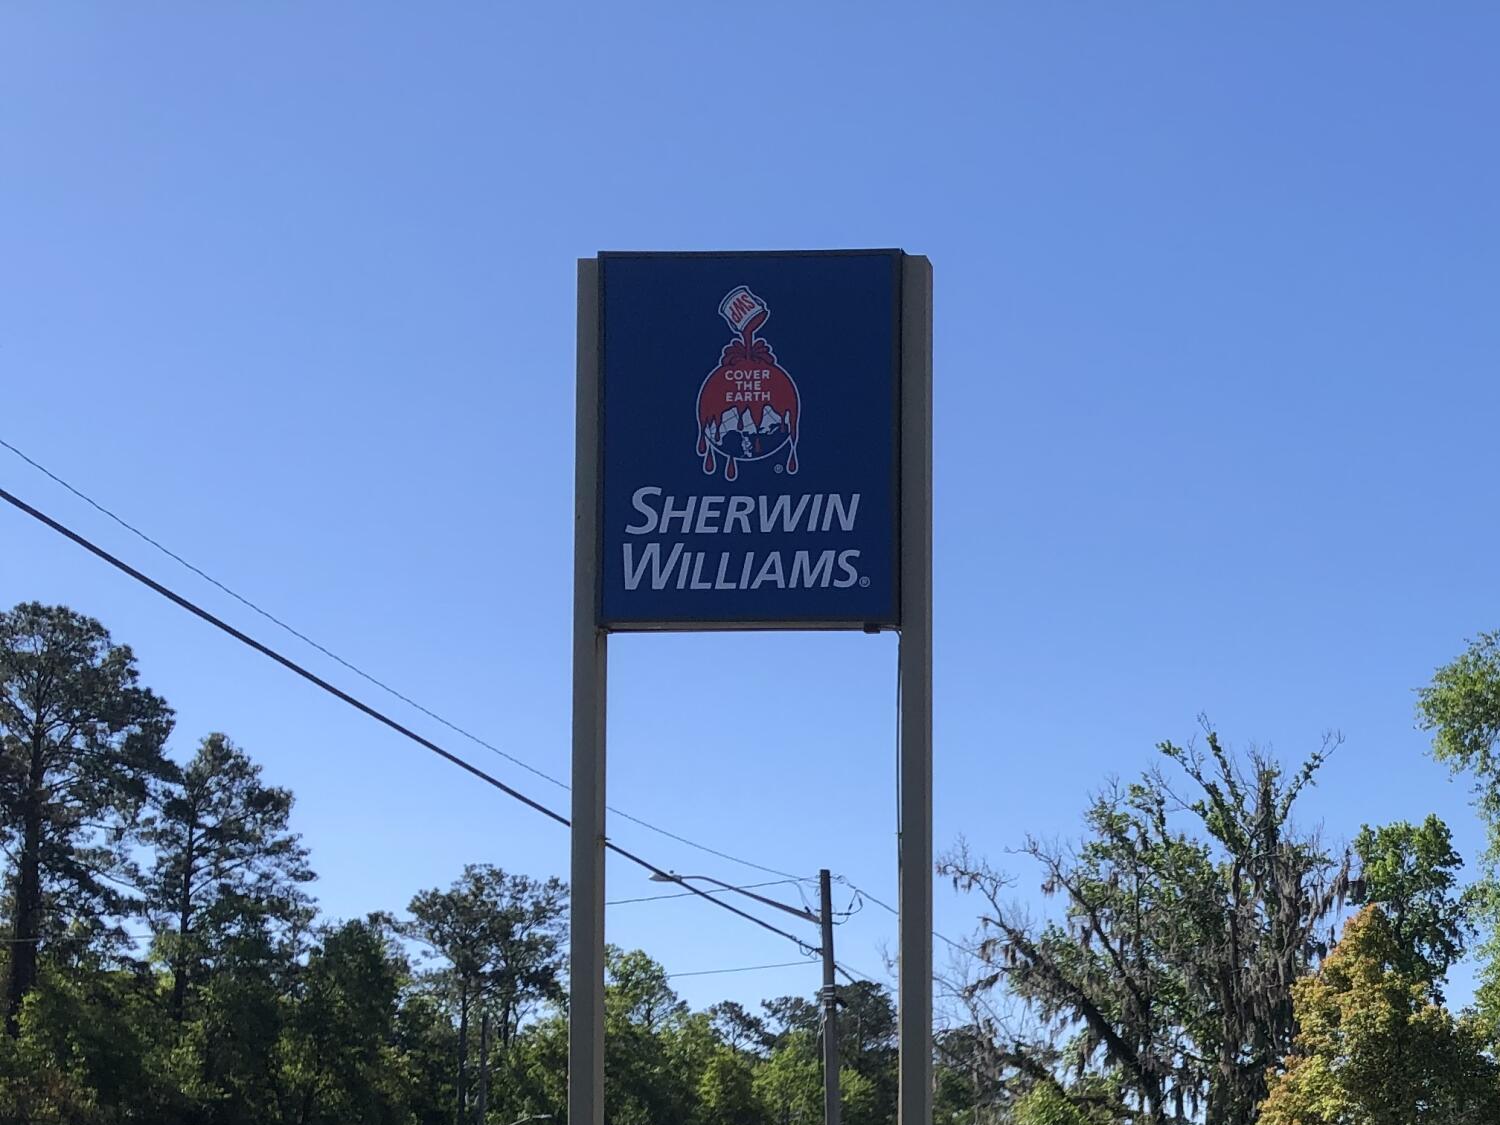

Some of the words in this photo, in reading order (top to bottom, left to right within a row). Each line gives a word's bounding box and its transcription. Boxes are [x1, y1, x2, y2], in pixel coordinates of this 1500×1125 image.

[729, 294, 756, 324] SWP
[725, 370, 770, 380] COVER
[726, 391, 771, 401] EARTH
[735, 381, 762, 391] THE
[624, 486, 860, 535] SHERWIN
[622, 542, 862, 590] WILLIAMS
